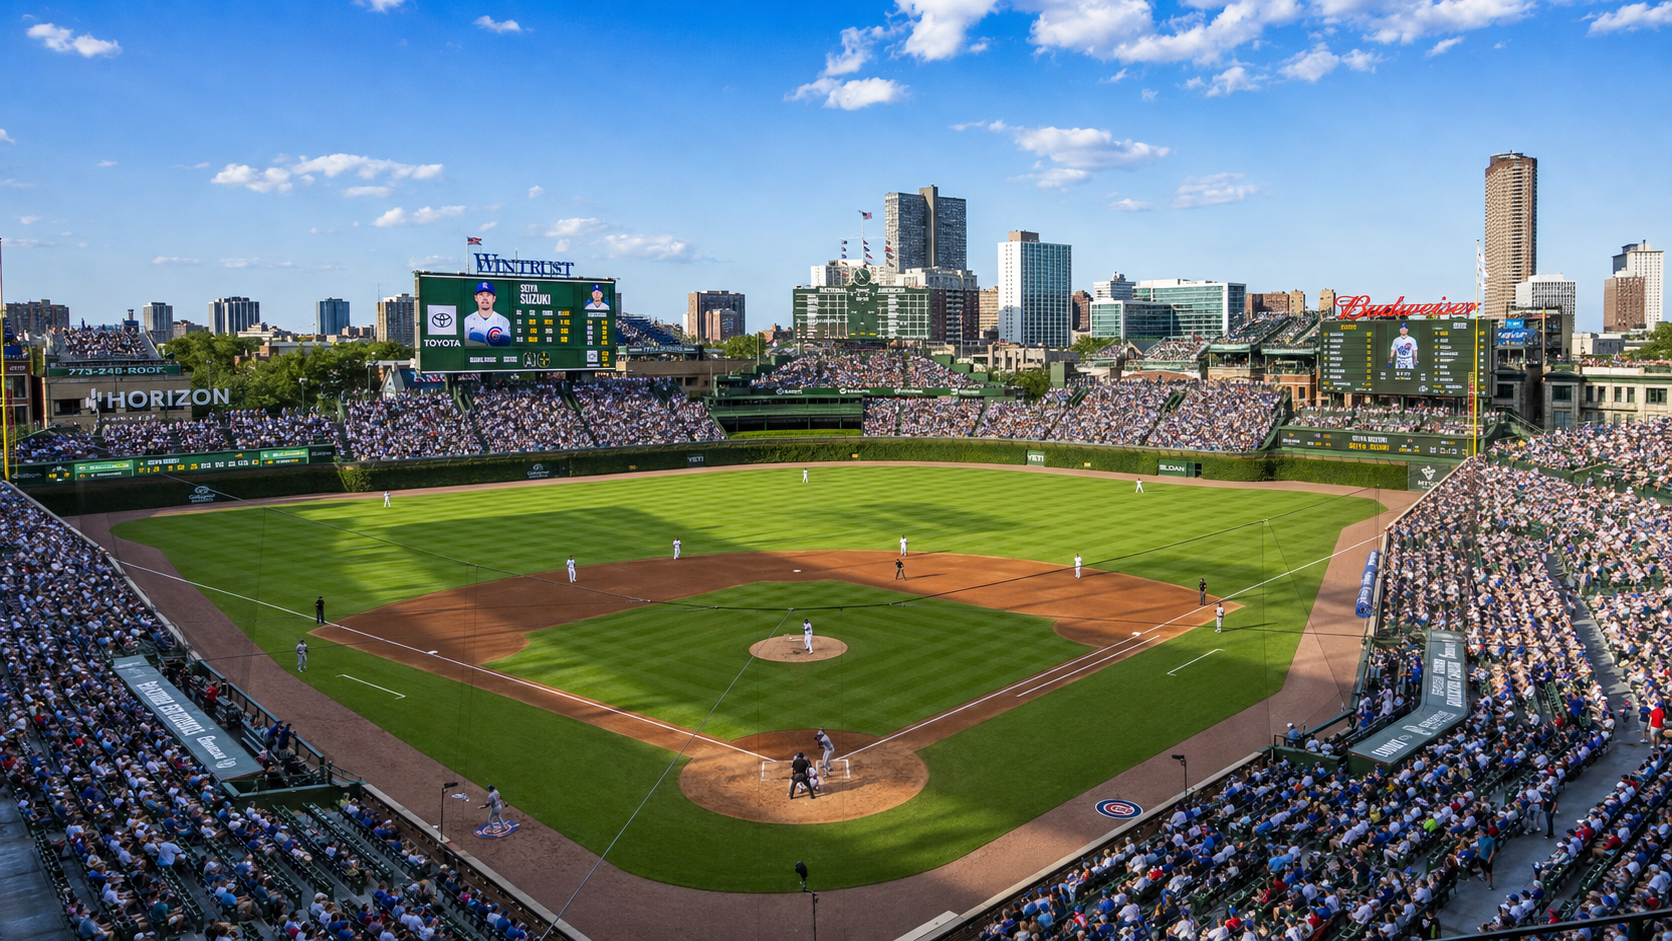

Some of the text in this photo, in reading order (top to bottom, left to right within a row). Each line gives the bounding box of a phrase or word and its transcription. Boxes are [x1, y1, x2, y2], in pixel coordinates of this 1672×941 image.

[520, 294, 551, 305] SUZUKI
[1335, 295, 1481, 320] Budweiser
[424, 339, 461, 347] TOYOTA
[107, 387, 230, 409] HORIZON
